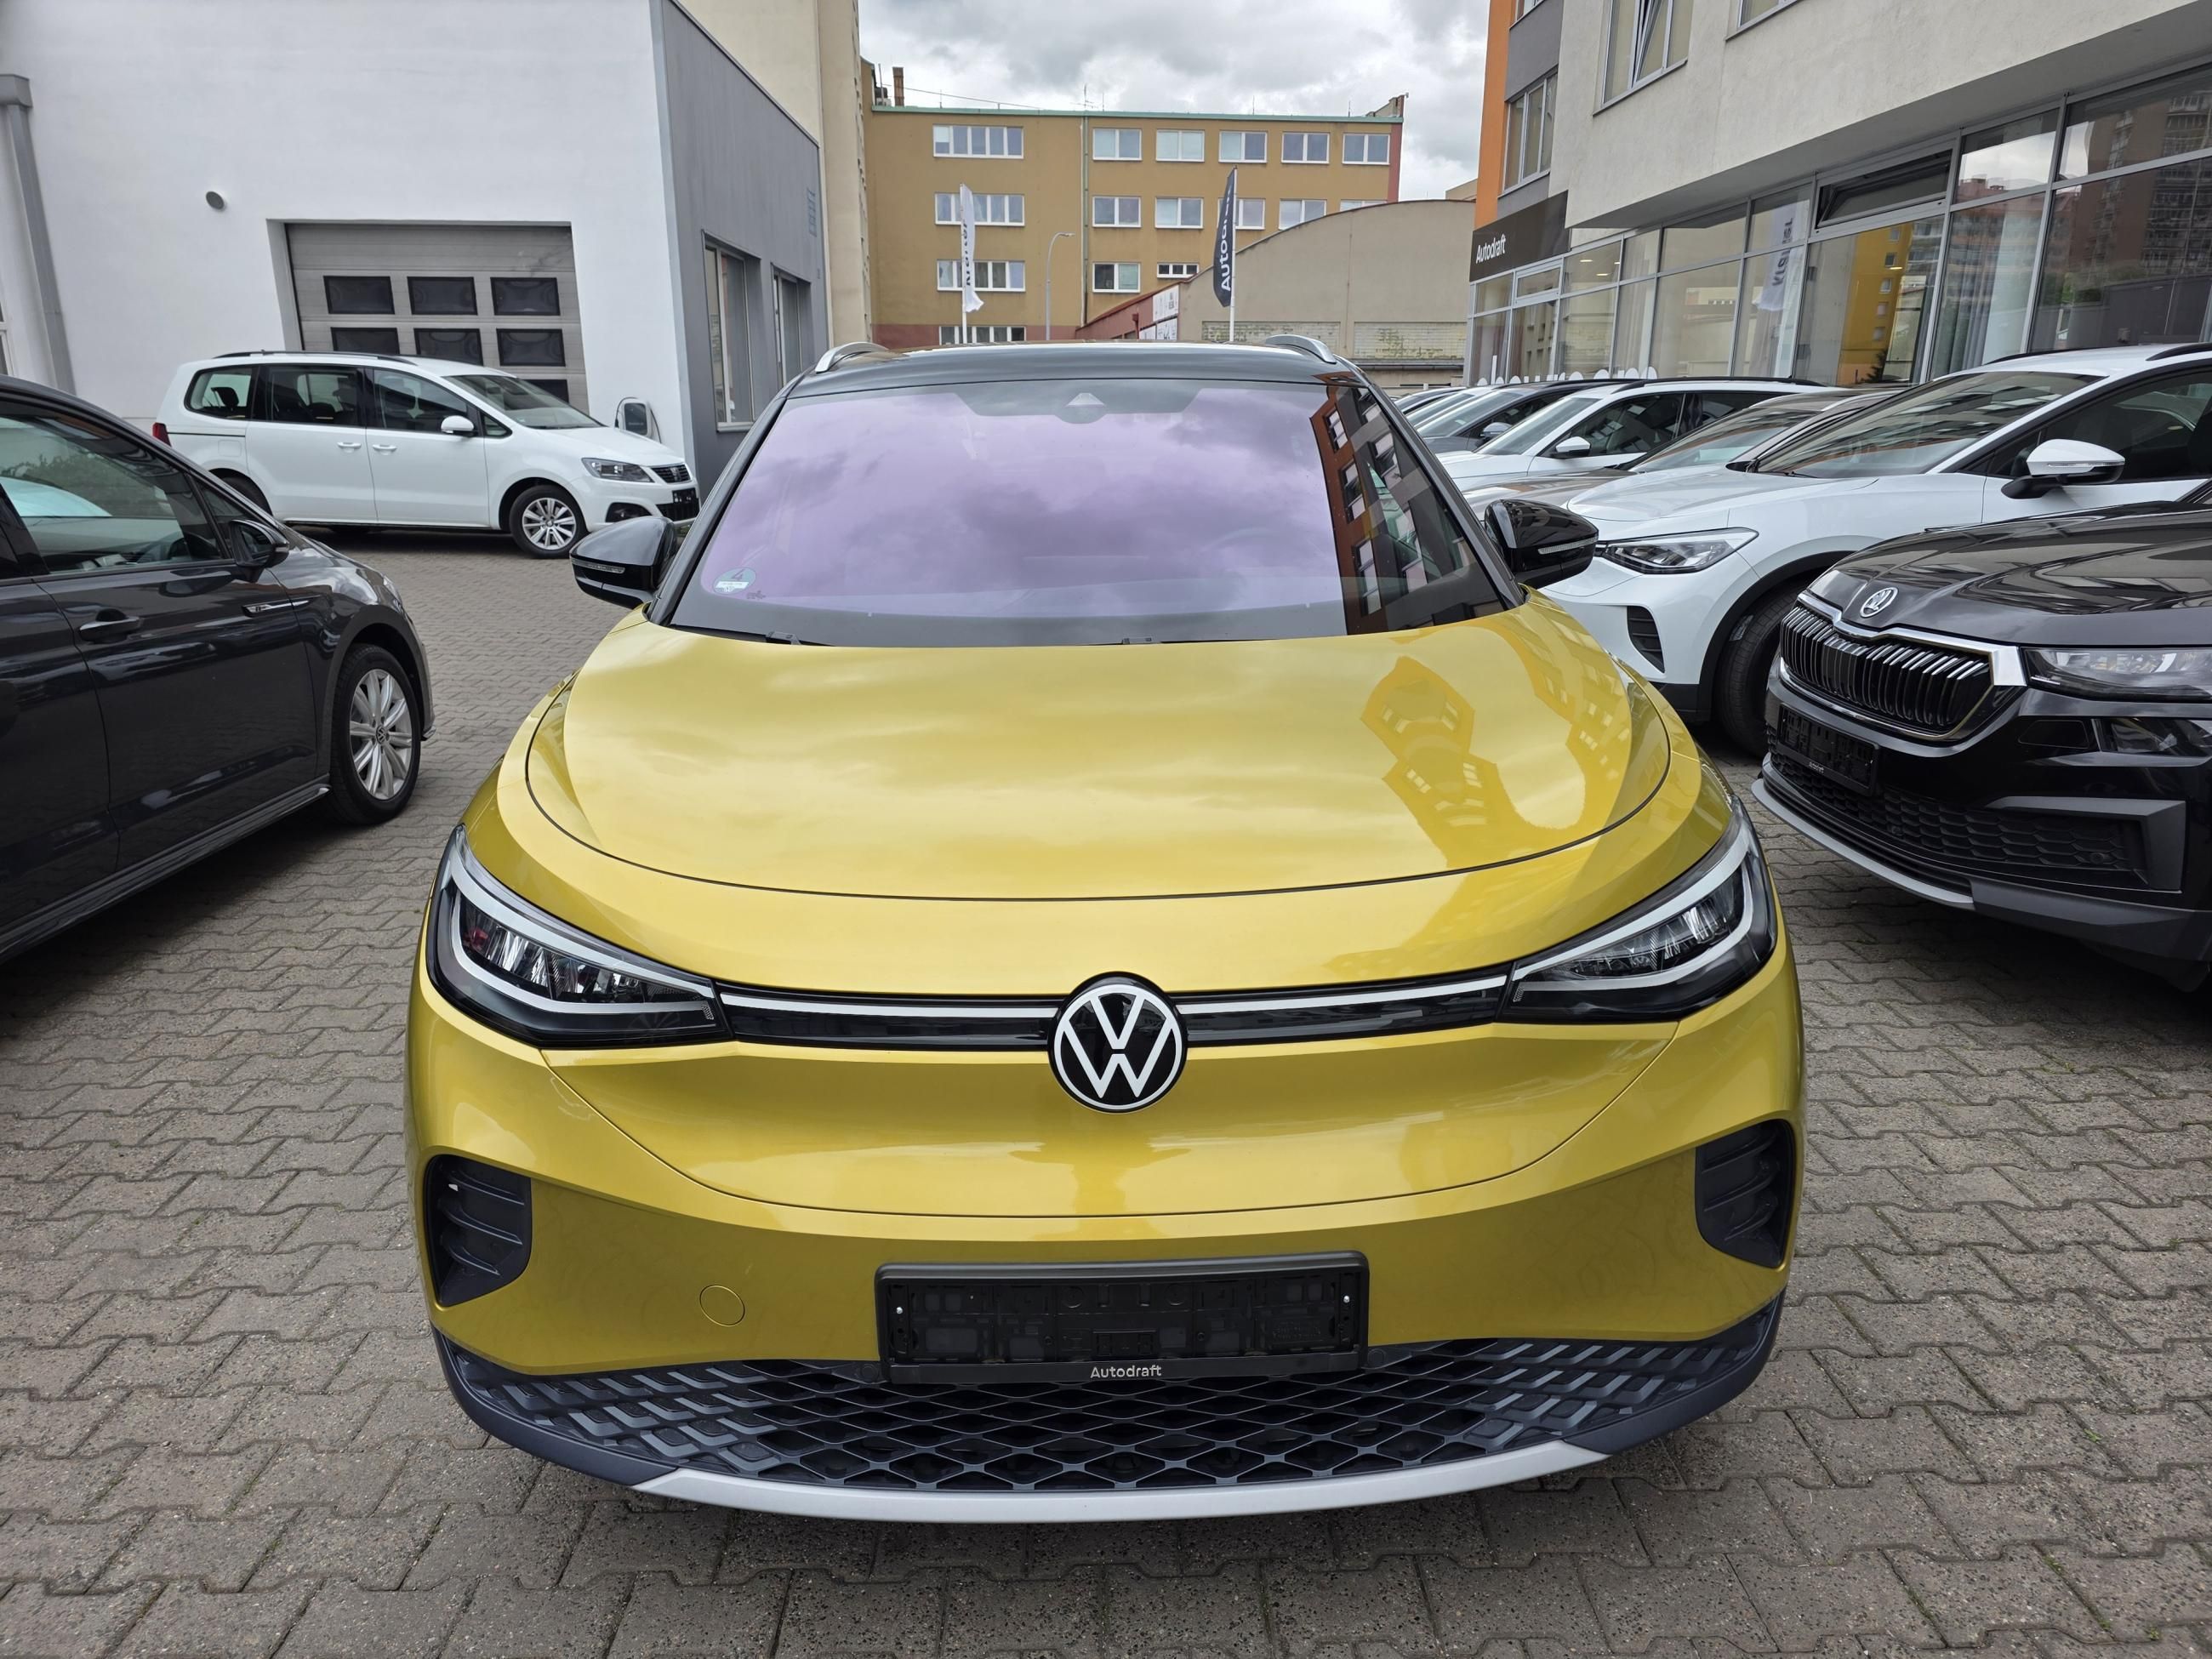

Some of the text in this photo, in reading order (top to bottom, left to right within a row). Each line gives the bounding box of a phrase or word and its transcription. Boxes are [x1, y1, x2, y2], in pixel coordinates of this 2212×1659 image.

[1476, 233, 1506, 264] Autodraft
[1054, 984, 1182, 1110] VW
[1090, 1365, 1162, 1378] Autodraft
